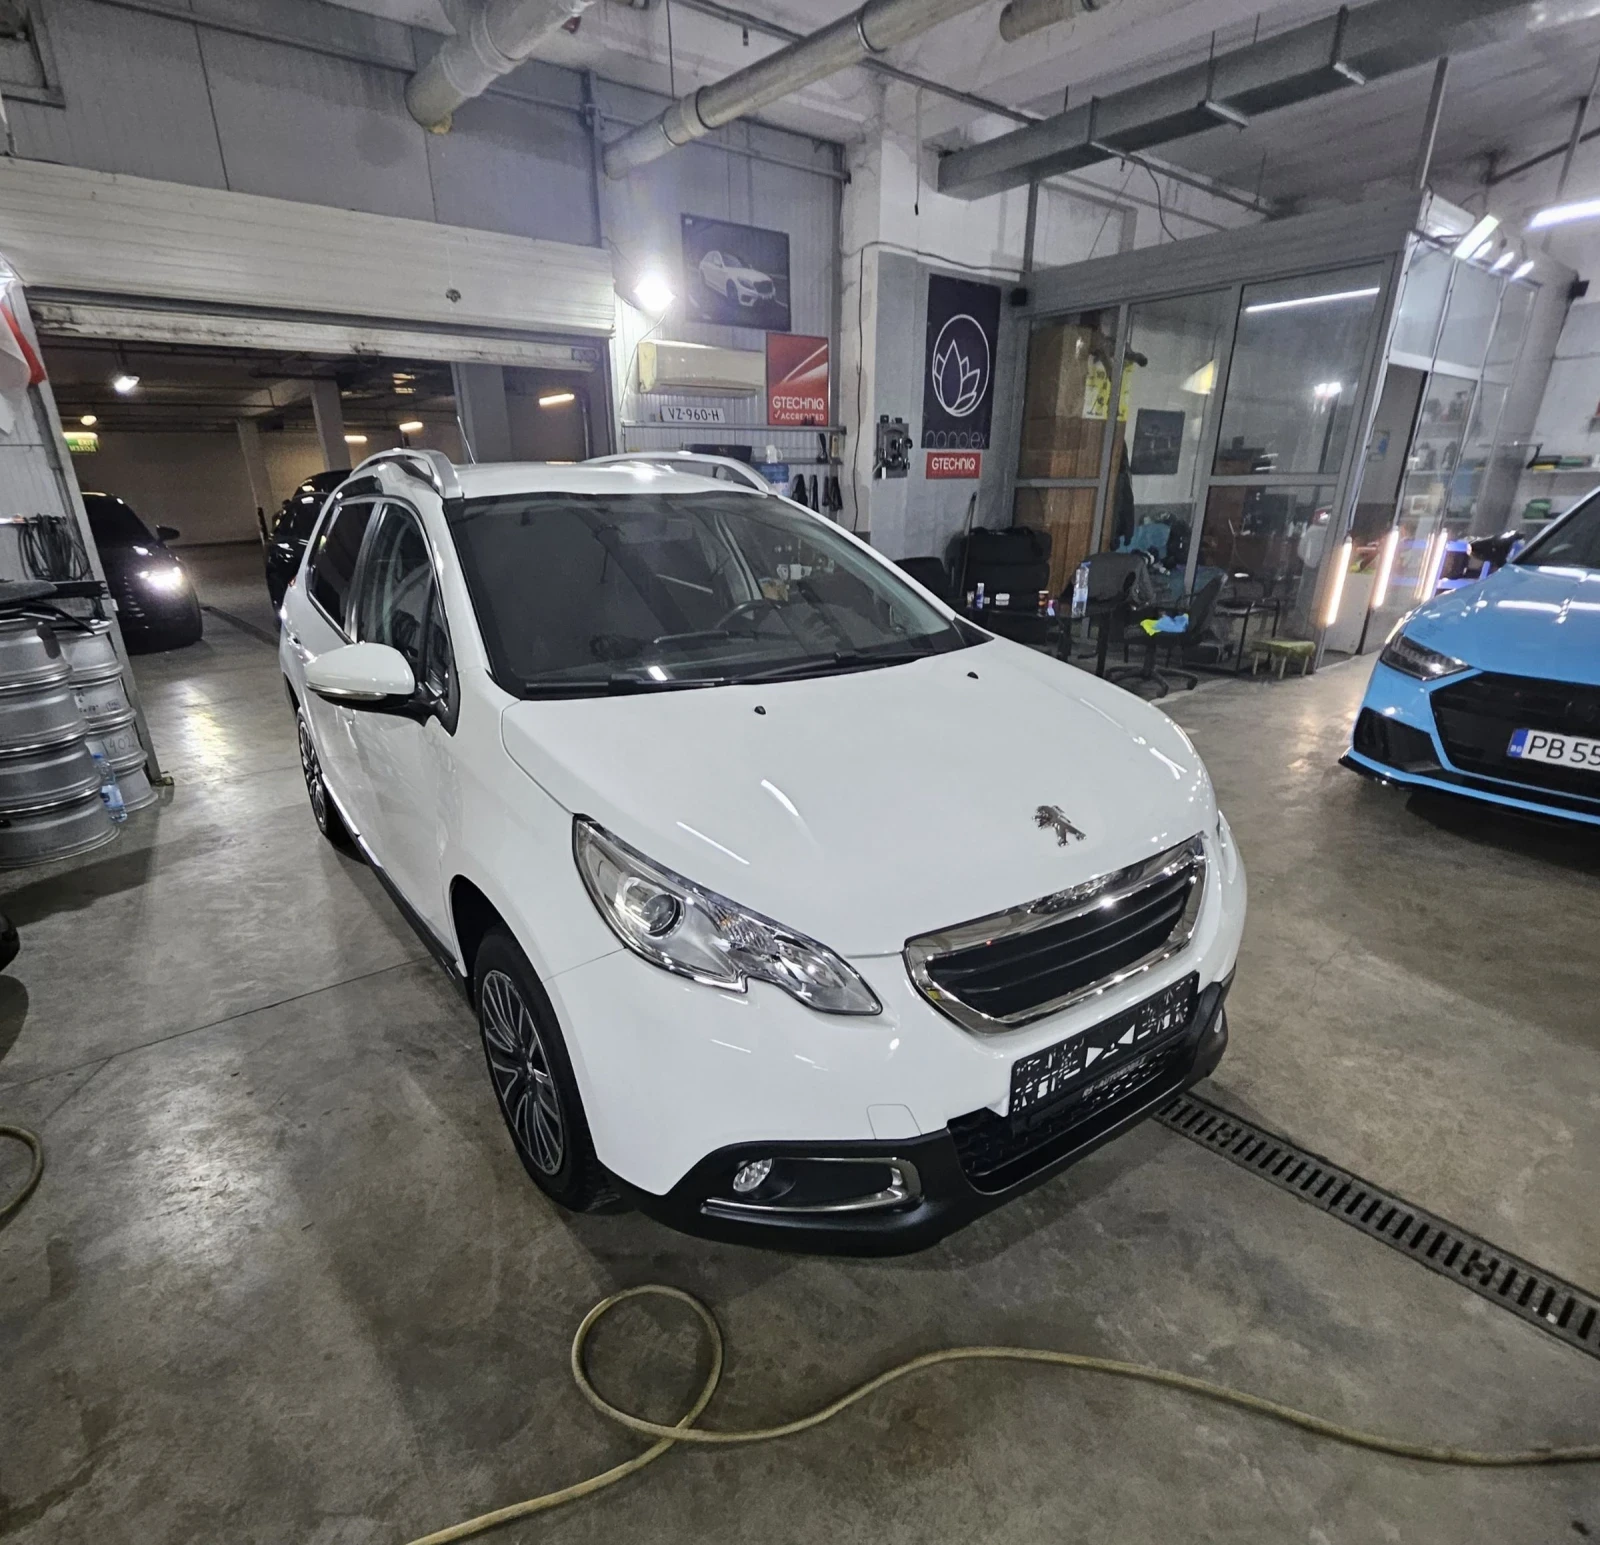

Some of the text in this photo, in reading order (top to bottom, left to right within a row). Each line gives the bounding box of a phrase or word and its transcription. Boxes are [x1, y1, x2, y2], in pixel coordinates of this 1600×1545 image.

[772, 395, 825, 411] GTECHNIQ
[667, 407, 720, 421] VZ-960-H
[931, 457, 976, 471] GTECHNIQ
[1528, 735, 1566, 760] PB
